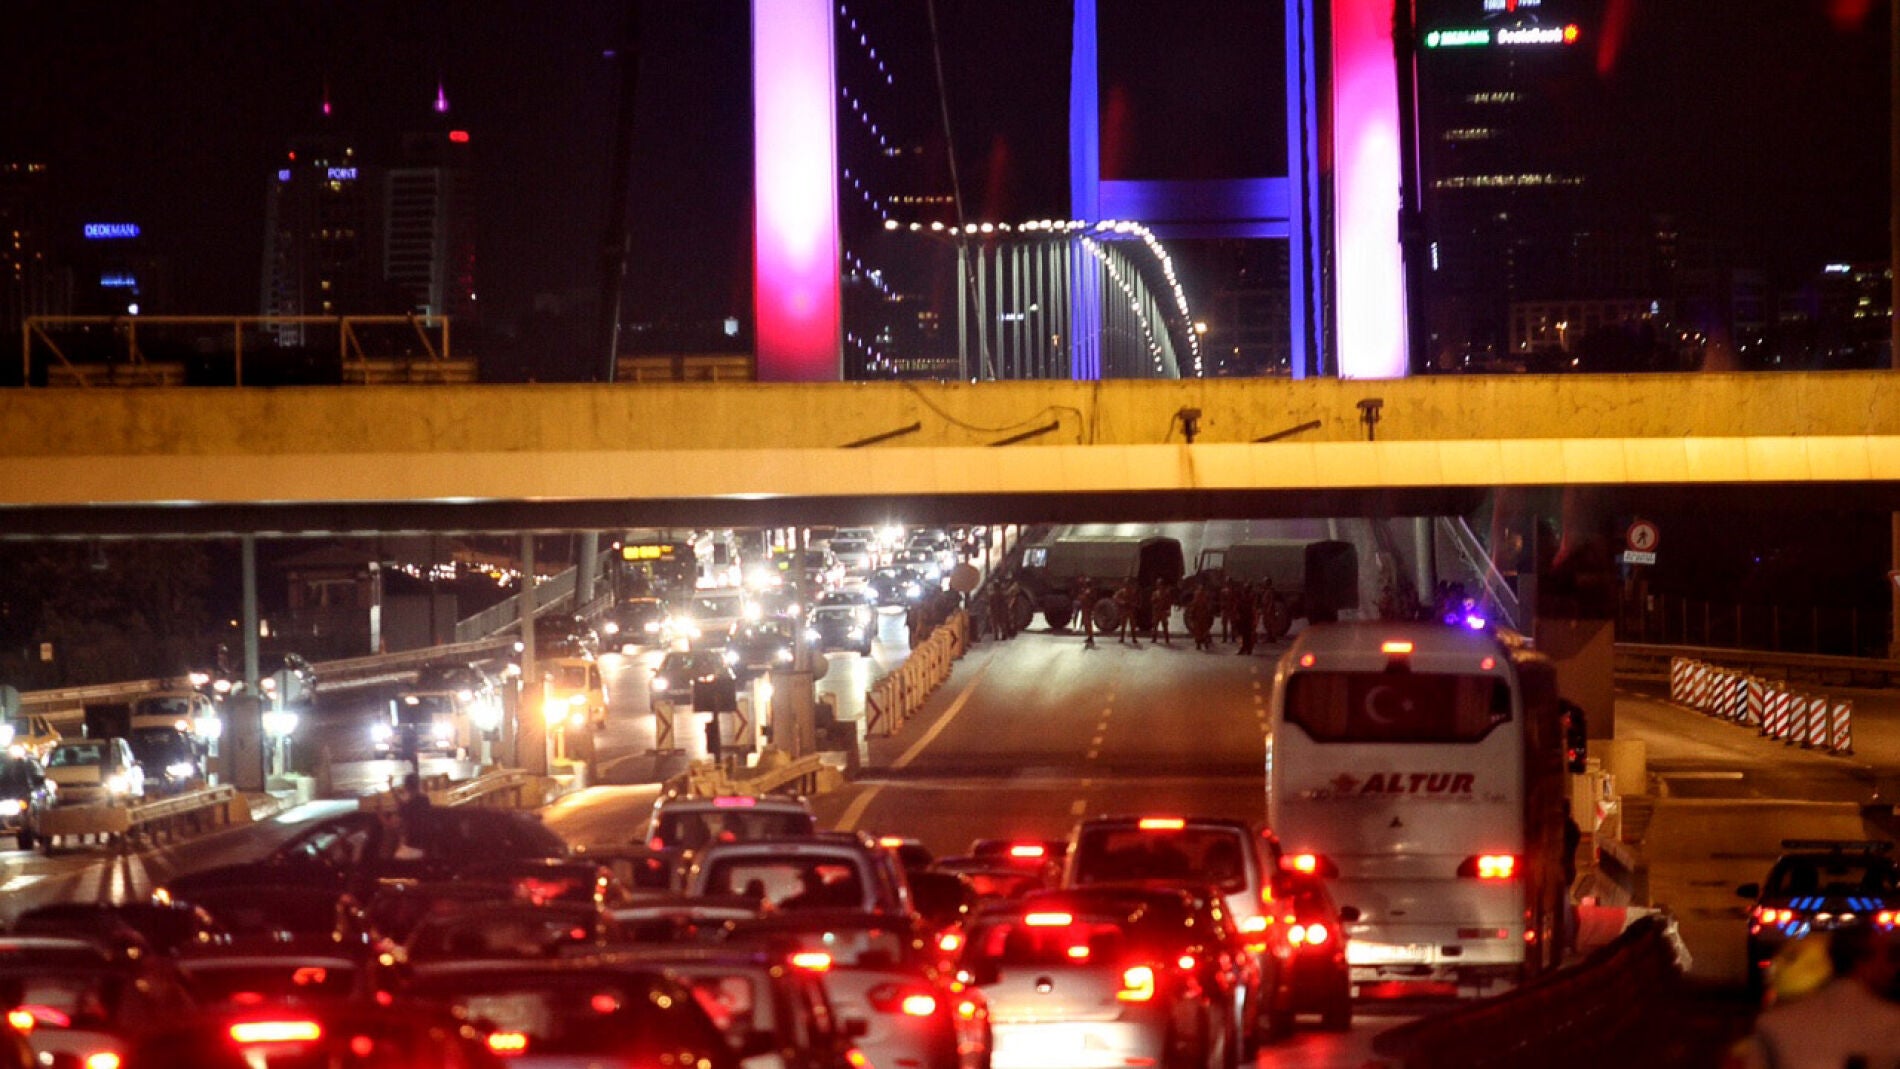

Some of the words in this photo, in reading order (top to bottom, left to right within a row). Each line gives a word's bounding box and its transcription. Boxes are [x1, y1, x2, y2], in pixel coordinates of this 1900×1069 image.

[328, 168, 357, 179] POINT
[84, 223, 136, 238] DEDEMAN
[1361, 772, 1475, 794] ALTUR
